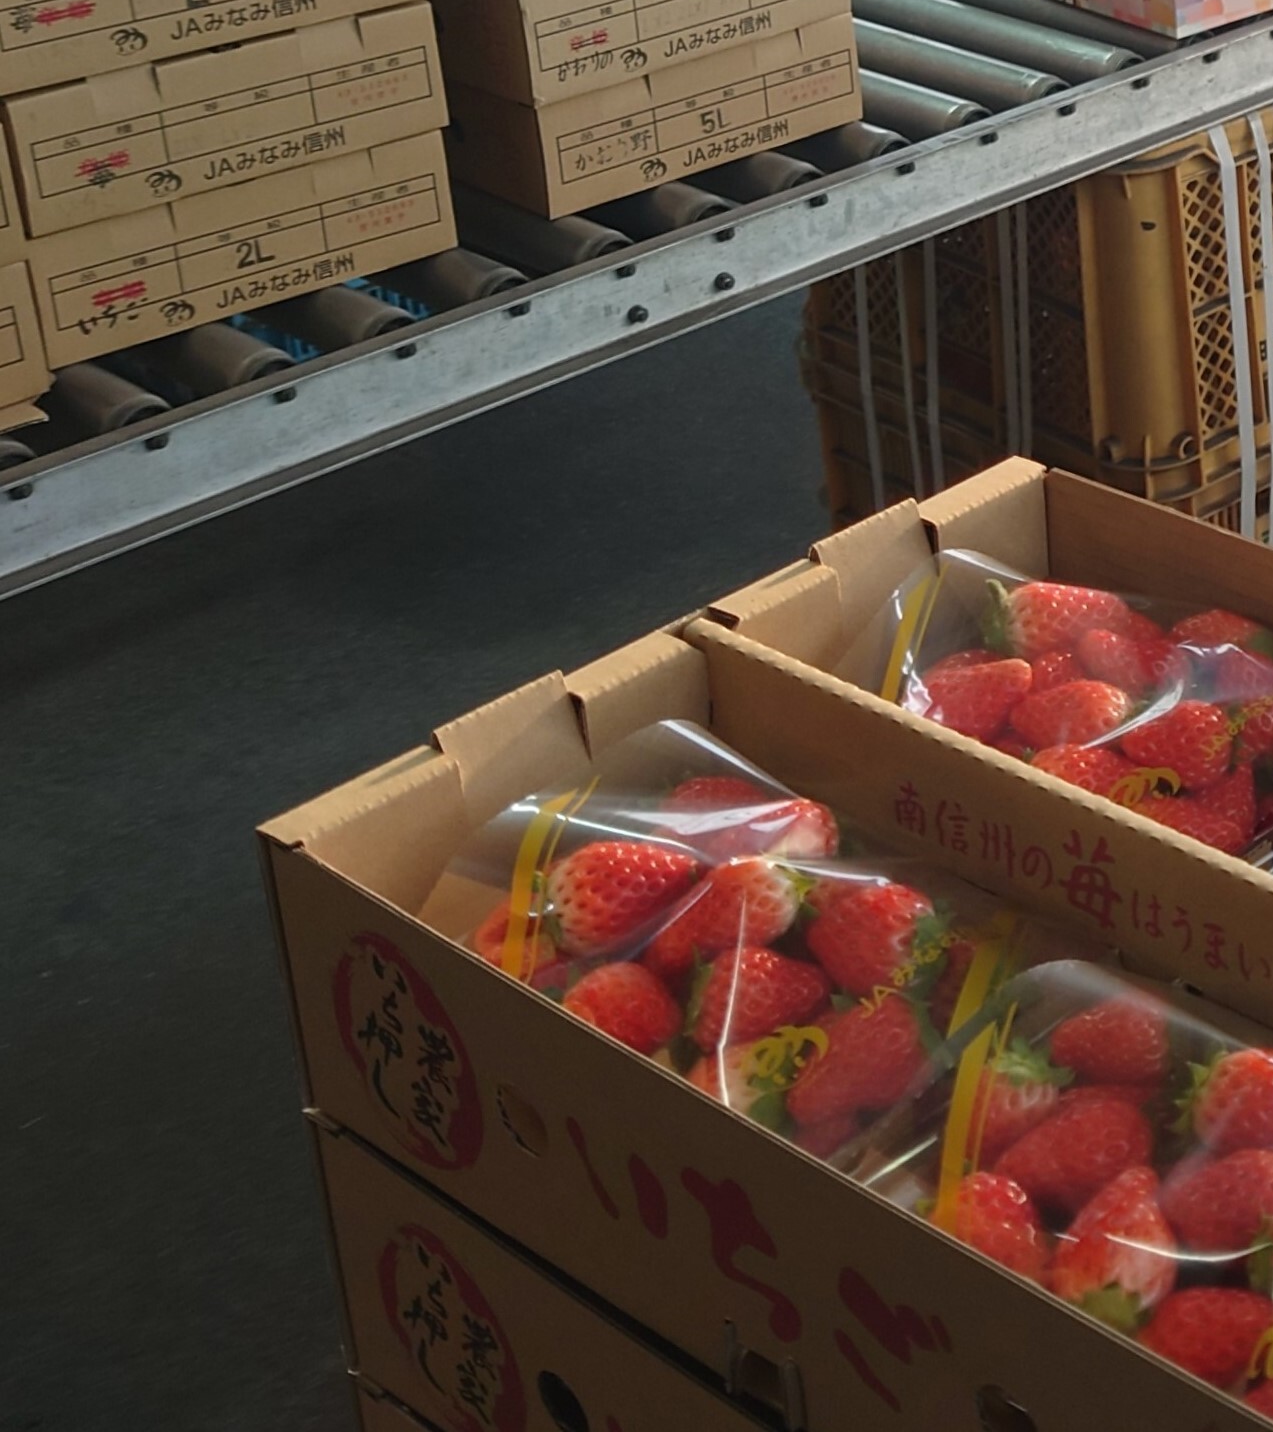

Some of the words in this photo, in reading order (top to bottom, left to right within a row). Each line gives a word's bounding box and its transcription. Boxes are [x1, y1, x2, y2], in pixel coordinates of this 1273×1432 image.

[664, 11, 772, 58] JAみなみ信州
[683, 120, 789, 167] JAみなみ信州
[701, 107, 732, 134] 5L
[203, 126, 346, 182] JAみなみ信州
[236, 239, 276, 270] 2L
[216, 252, 355, 310] JAみなみ信州
[566, 1115, 953, 1414] いちご
